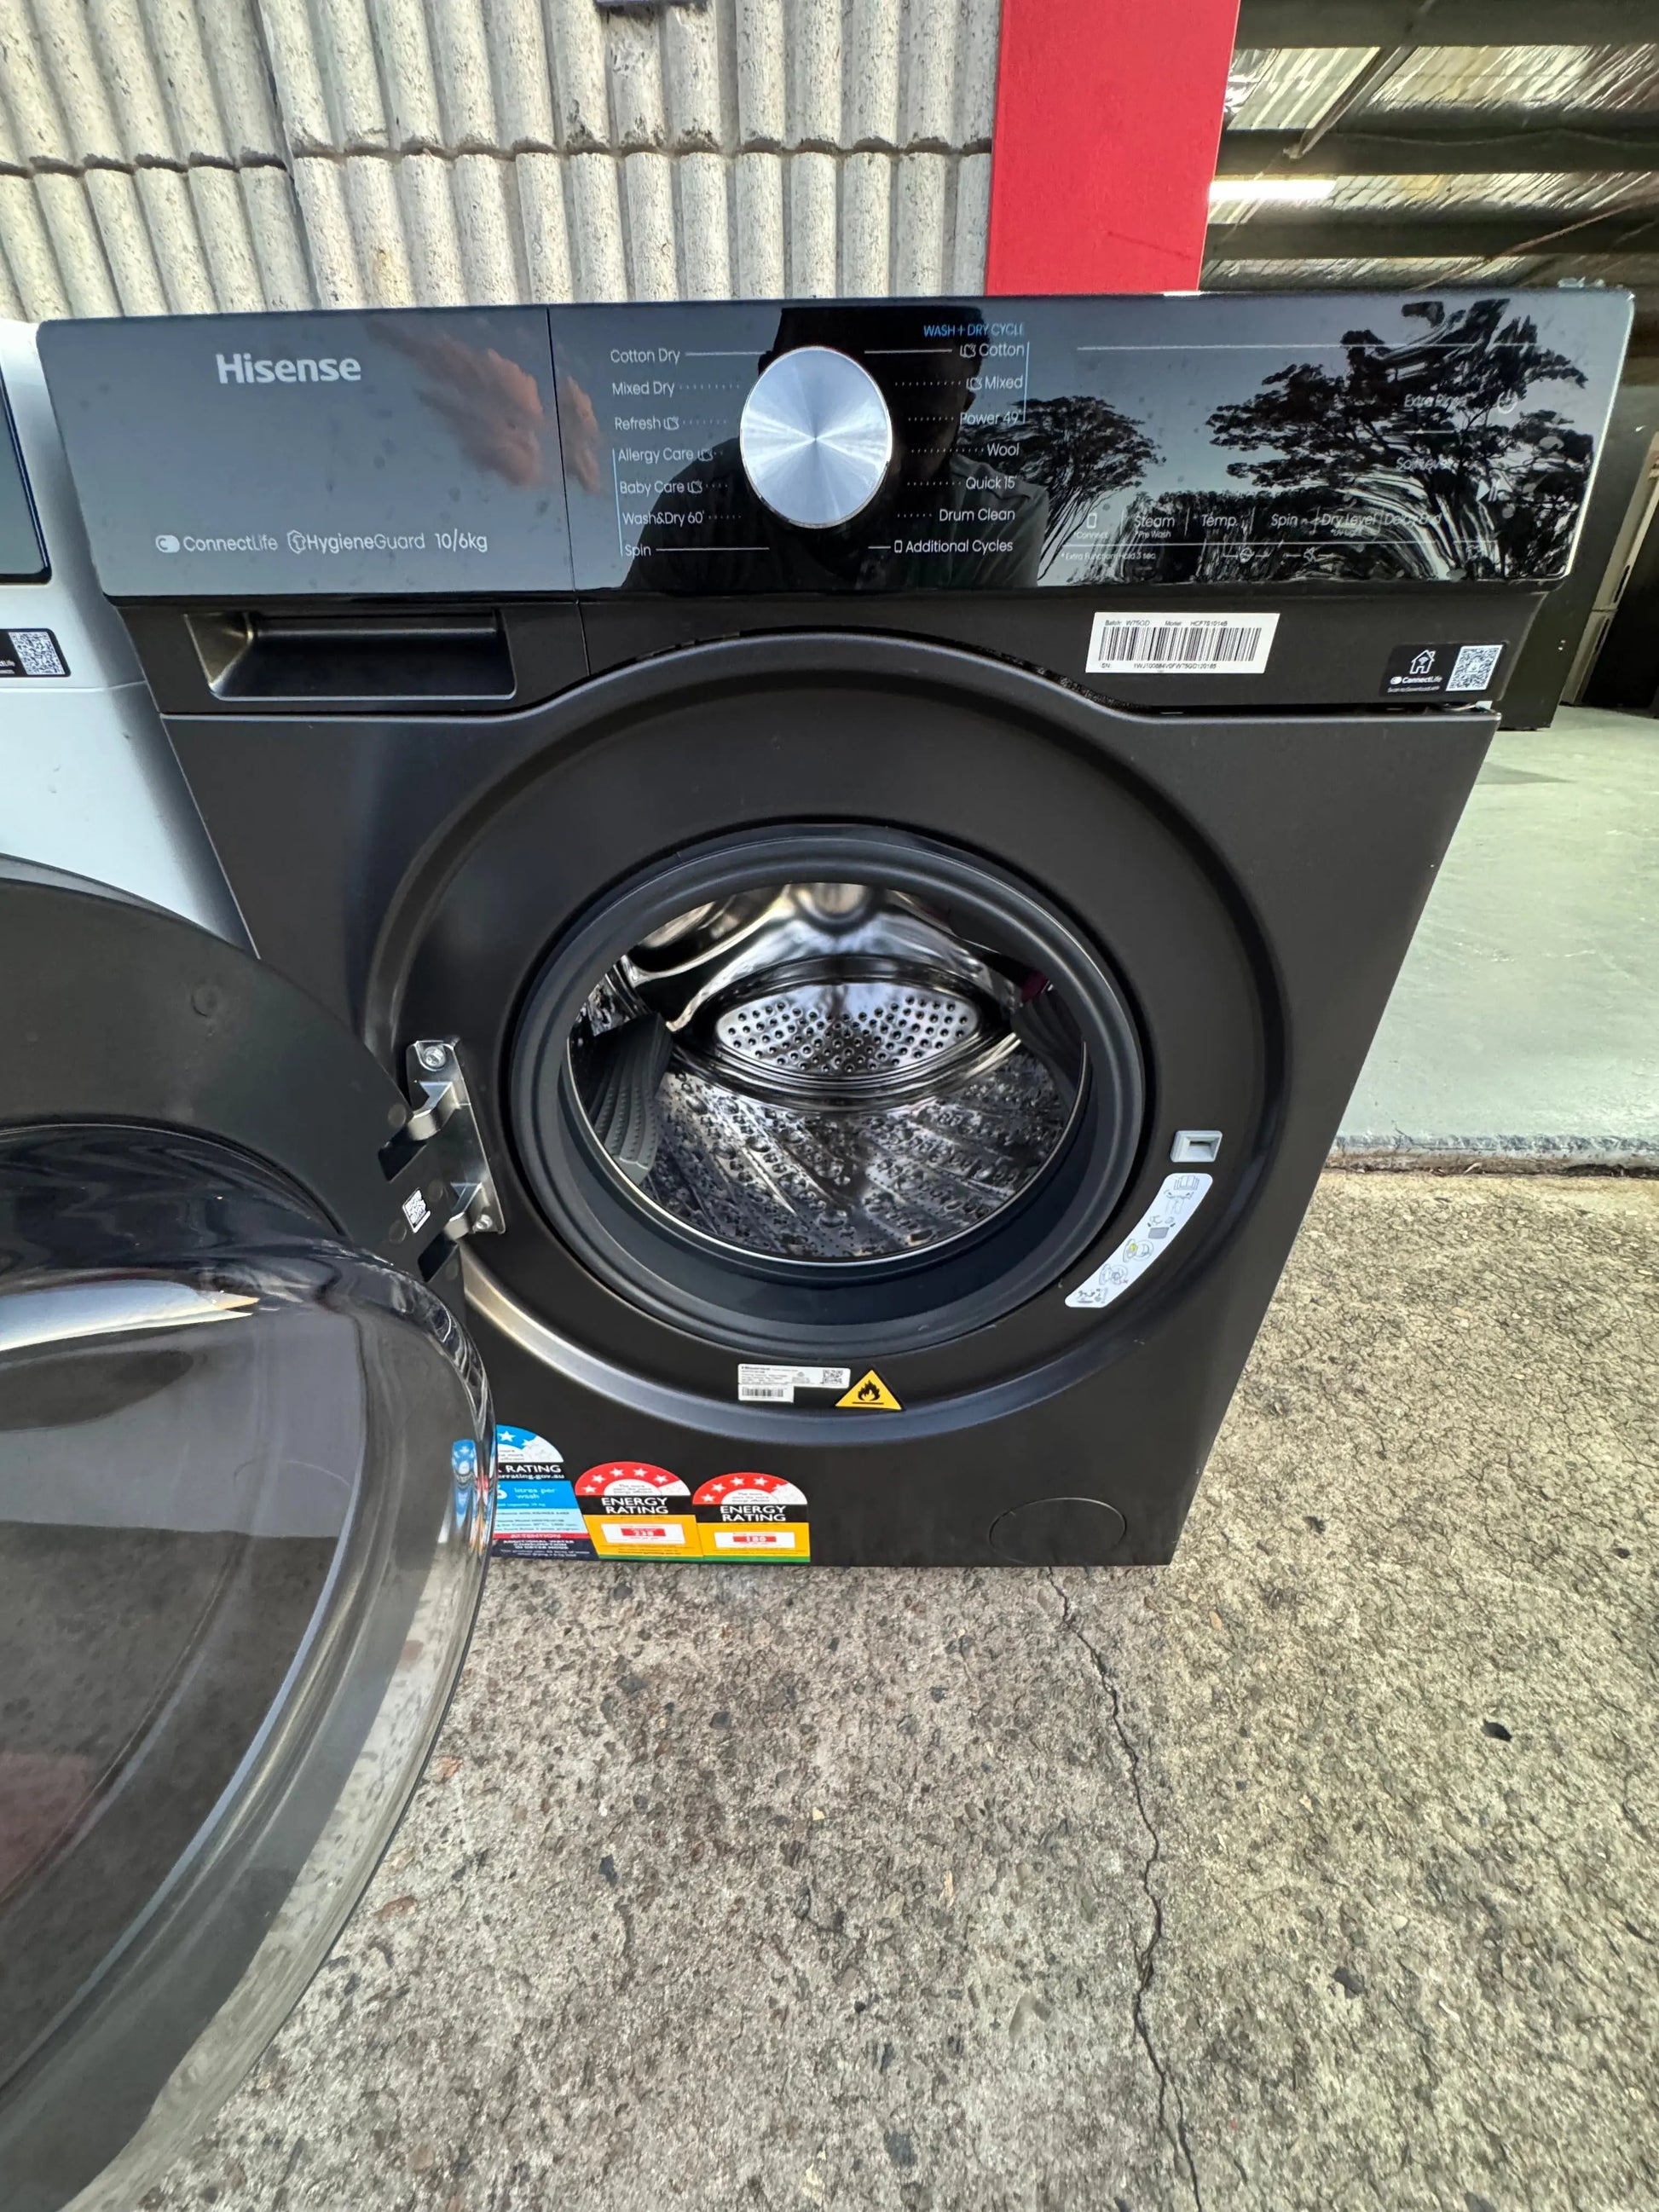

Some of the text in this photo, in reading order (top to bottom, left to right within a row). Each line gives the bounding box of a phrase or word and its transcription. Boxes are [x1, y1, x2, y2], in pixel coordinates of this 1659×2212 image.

[923, 324, 955, 338] WASH
[967, 323, 989, 336] DRY
[610, 347, 680, 366] Cotton Dry
[979, 344, 1025, 356] Cotton
[216, 353, 361, 384] Hisense
[612, 380, 674, 397] Mixed Dry
[985, 376, 1023, 390] Mixed
[615, 416, 662, 430] Refresh
[960, 412, 1000, 425] Power
[618, 446, 693, 465] Allergy Care
[986, 443, 1020, 456] Wool
[620, 480, 685, 497] Baby Care
[965, 476, 1001, 490] Quick
[622, 511, 685, 527] Wash&Dry
[939, 507, 1015, 522] Drum Clean
[1134, 515, 1176, 528] Steam
[1270, 513, 1298, 527] Spin
[1321, 513, 1341, 527] Dry
[183, 528, 488, 554] ConnectLife HygieneGuard 10/6kg
[1151, 530, 1172, 539] Wash
[625, 544, 651, 557] Spin
[905, 538, 1014, 555] Additional Cycles
[505, 1464, 562, 1473] RATING
[601, 1497, 668, 1506] ENERGY
[720, 1505, 787, 1514] ENERGY
